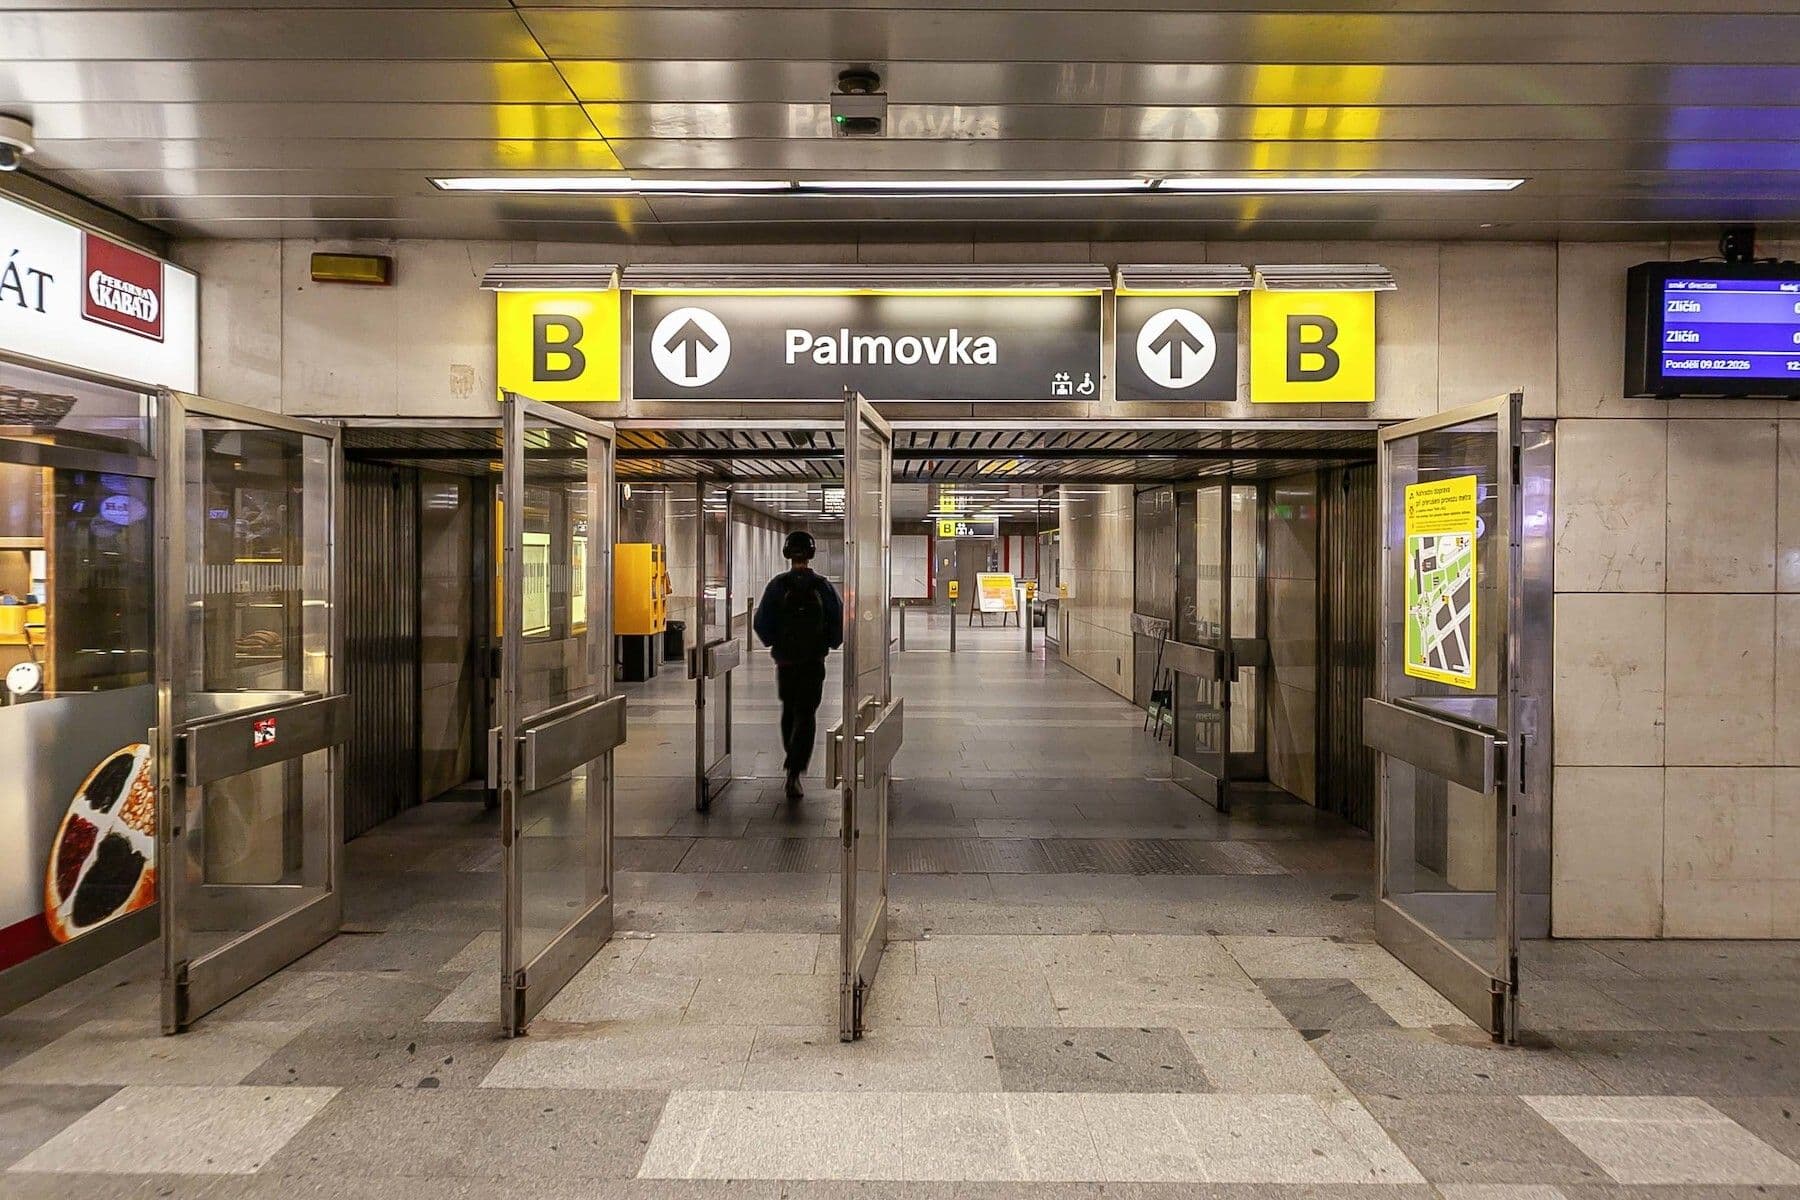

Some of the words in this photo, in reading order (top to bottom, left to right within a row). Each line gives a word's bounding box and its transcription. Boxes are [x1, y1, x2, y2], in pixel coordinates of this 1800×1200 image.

[1667, 300, 1701, 312] Zličín
[533, 314, 586, 382] B
[785, 328, 997, 365] Palmovka
[1286, 314, 1340, 382] B
[1666, 330, 1700, 342] Zličín
[943, 523, 951, 533] B
